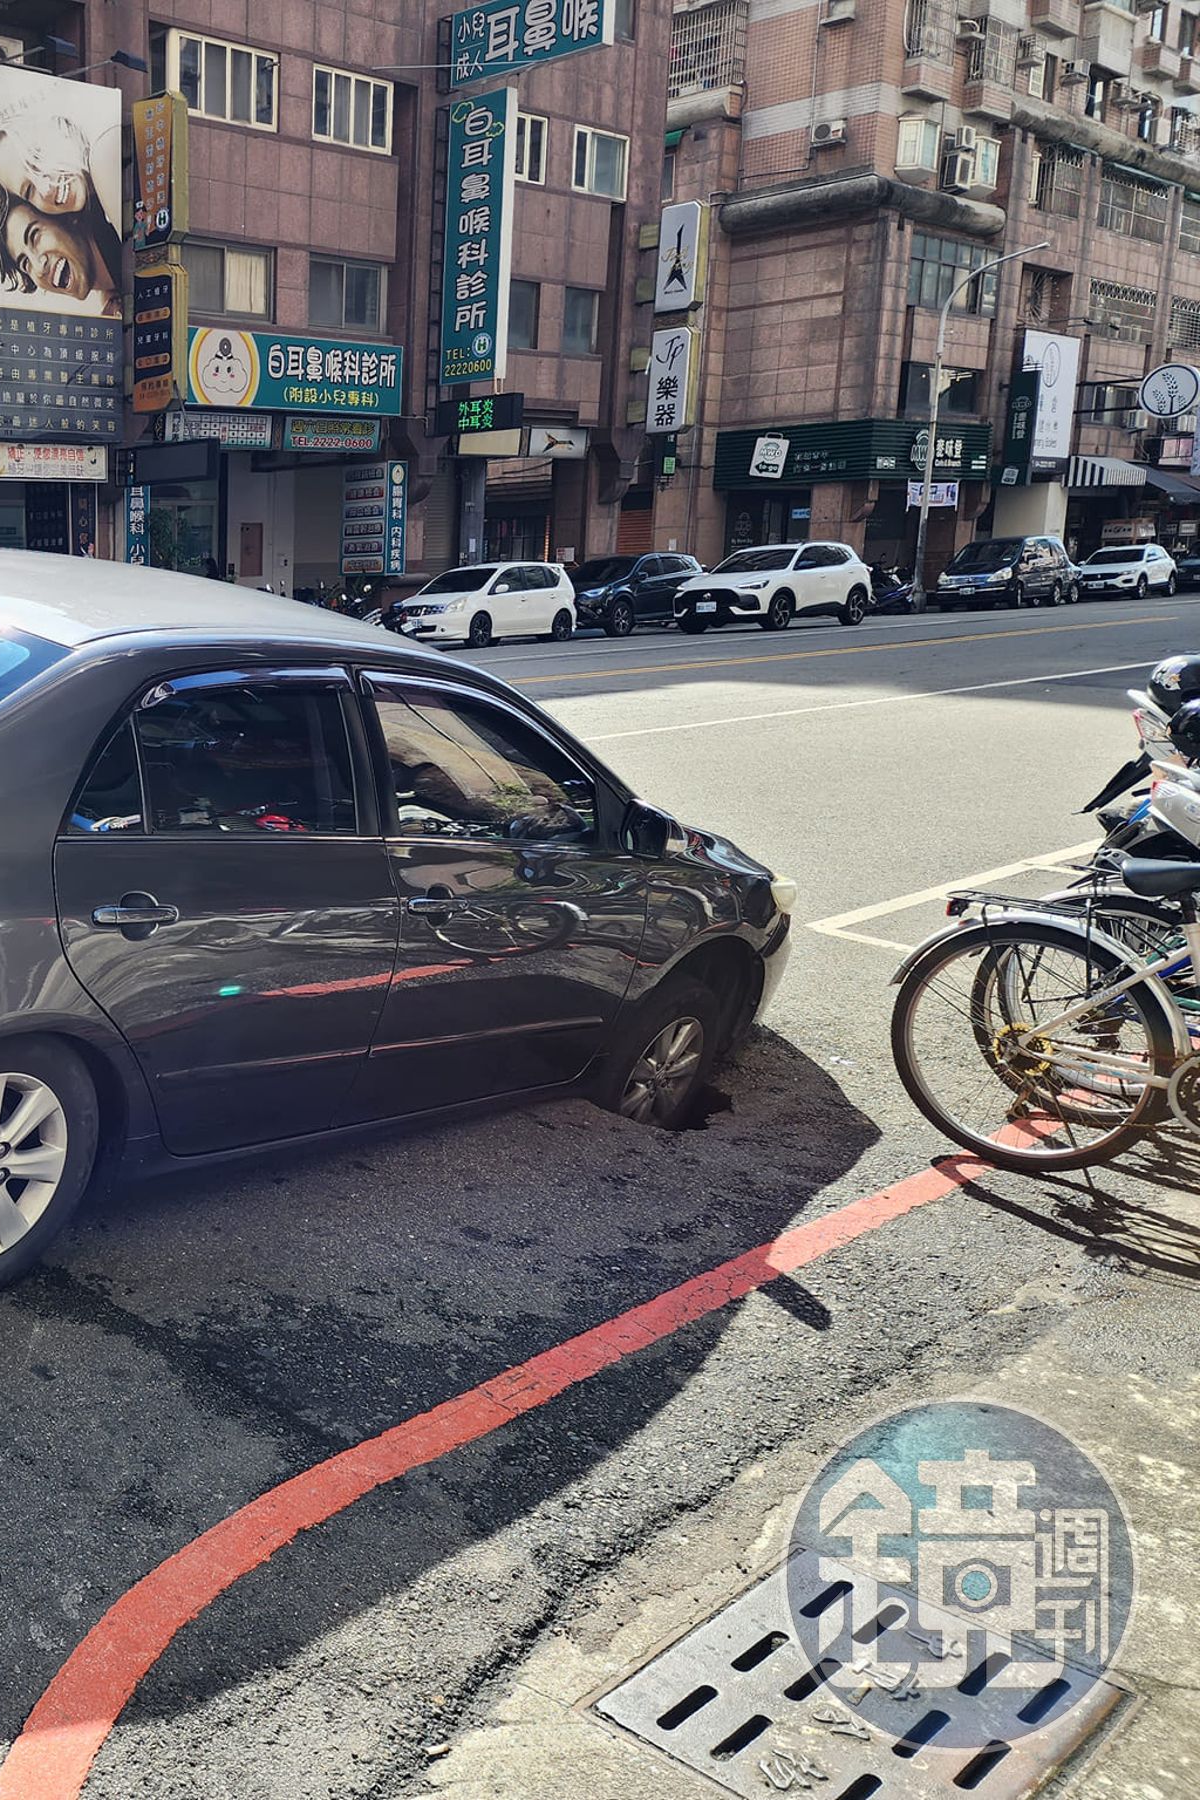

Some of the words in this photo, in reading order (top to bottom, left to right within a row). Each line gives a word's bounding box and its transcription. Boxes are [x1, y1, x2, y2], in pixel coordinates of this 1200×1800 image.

[457, 11, 485, 43] 小兒
[456, 50, 483, 81] 成人
[455, 106, 494, 332] 白耳鼻喉科診所
[268, 343, 397, 388] 白耳鼻喉科診所
[444, 358, 492, 377] 22220600
[283, 386, 380, 408] (附設小兒專科)
[457, 399, 494, 416] 外耳炎
[654, 375, 679, 427] 樂器
[457, 415, 494, 431] 中耳炎
